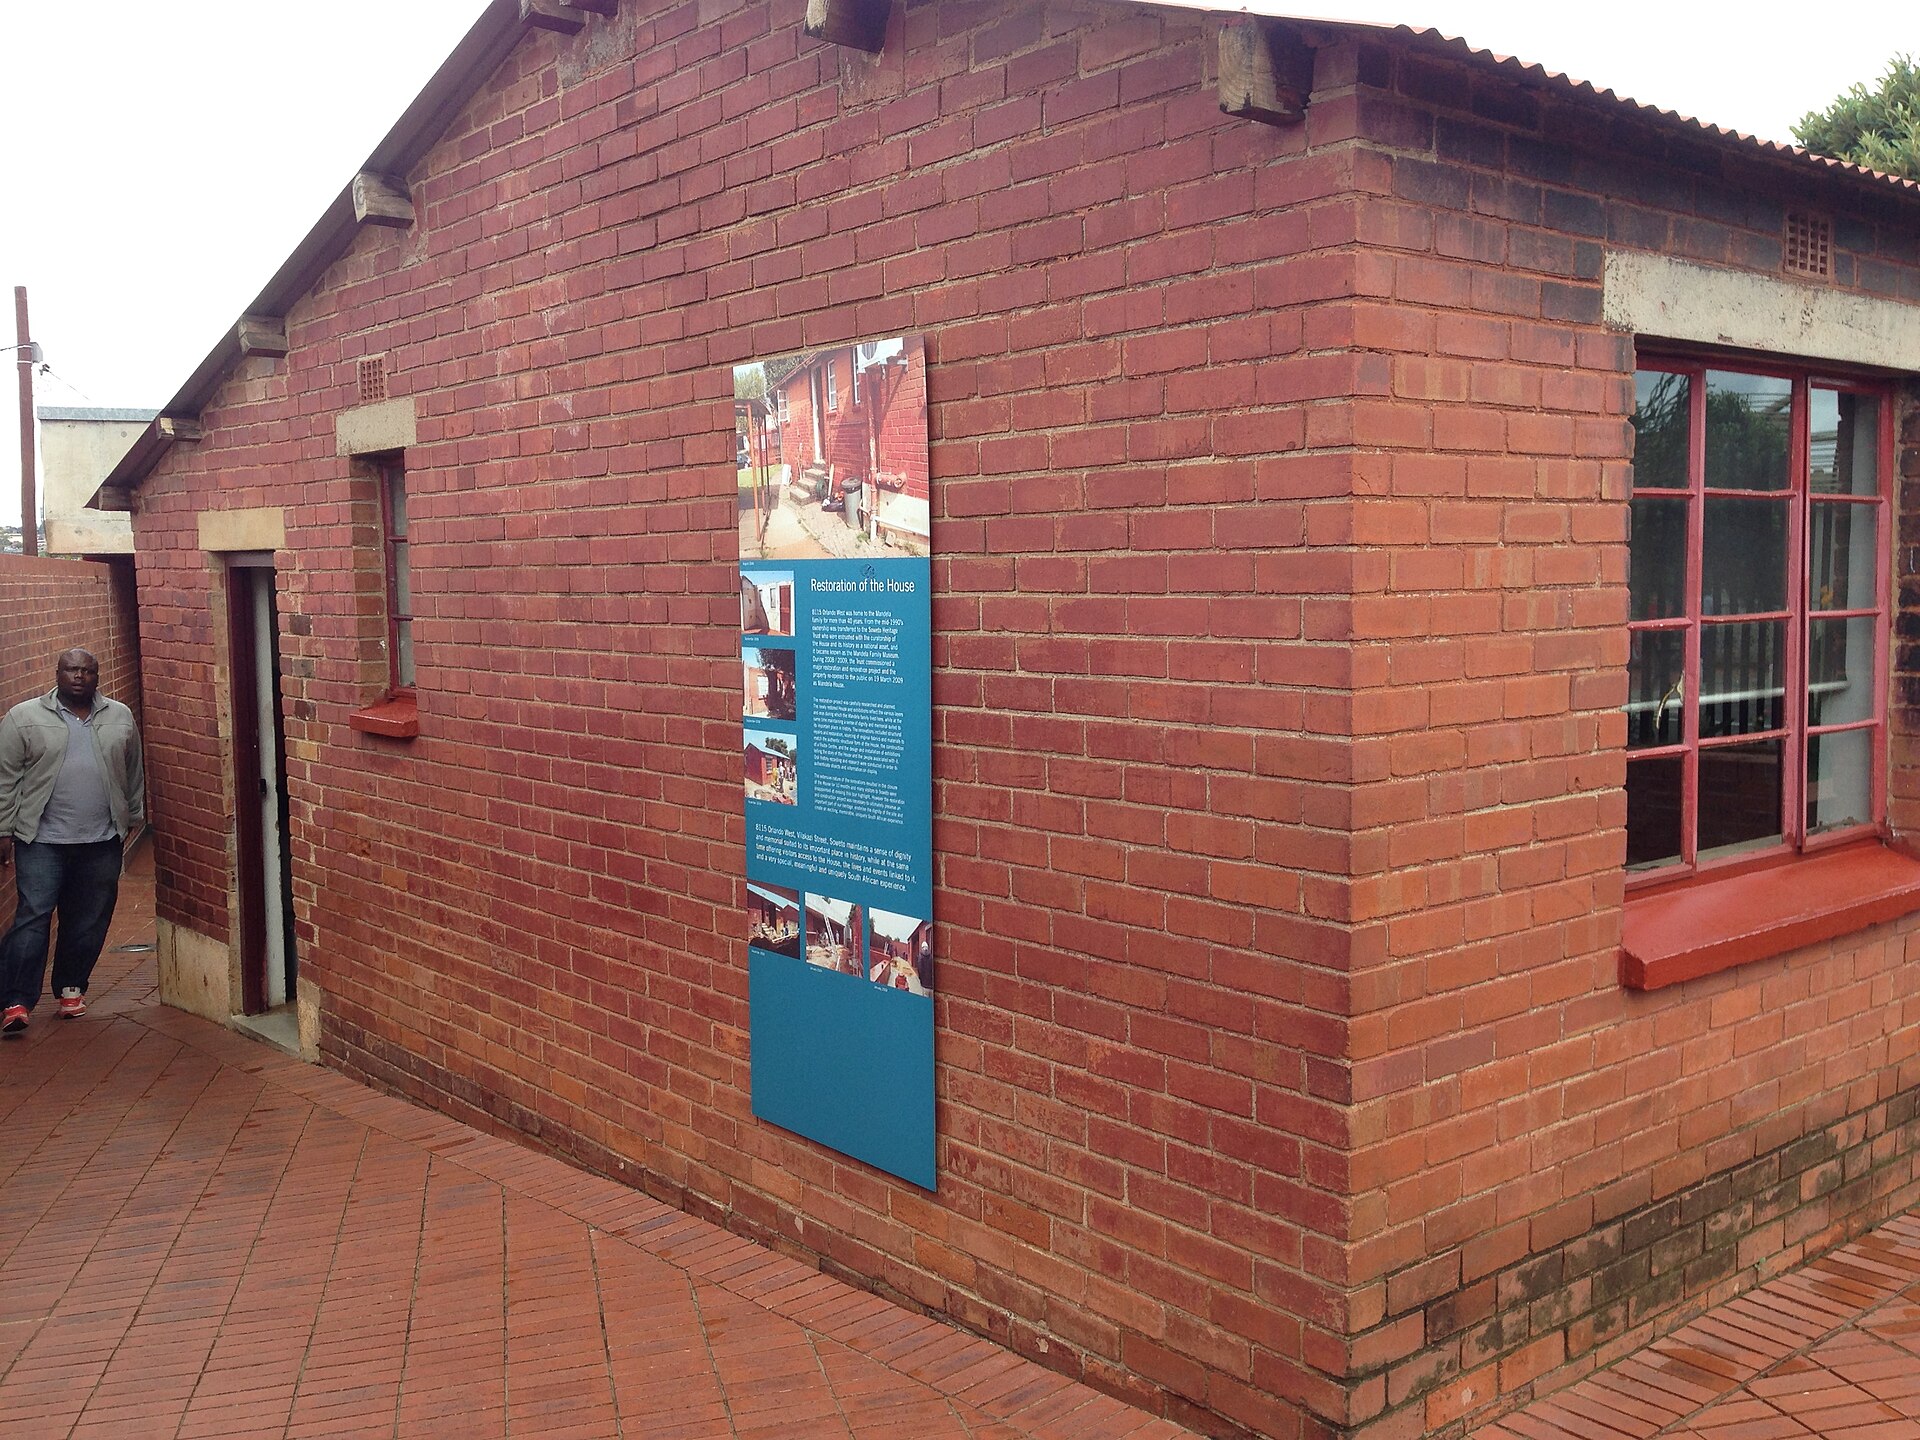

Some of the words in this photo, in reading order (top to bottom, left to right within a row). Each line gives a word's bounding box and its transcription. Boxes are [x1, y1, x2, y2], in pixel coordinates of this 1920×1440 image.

[811, 578, 857, 592] Restoration
[858, 578, 868, 592] of
[870, 578, 884, 592] the
[886, 578, 915, 593] House
[755, 823, 767, 832] 8115
[767, 826, 784, 836] Orlando
[796, 831, 813, 841] Vilakazi
[829, 838, 846, 848] Soweto
[846, 842, 869, 853] maintains
[873, 848, 888, 856] sense
[894, 851, 912, 862] dignity
[764, 836, 784, 845] memorial
[809, 844, 831, 855] important
[831, 849, 843, 857] place
[867, 857, 880, 865] while
[756, 843, 765, 851] time
[782, 849, 797, 858] visitors
[851, 863, 862, 872] lives
[872, 869, 888, 877] events
[888, 871, 904, 881] linked
[794, 862, 818, 872] meaningful
[828, 869, 847, 880] uniquely
[847, 872, 861, 882] South
[862, 876, 879, 885] African
